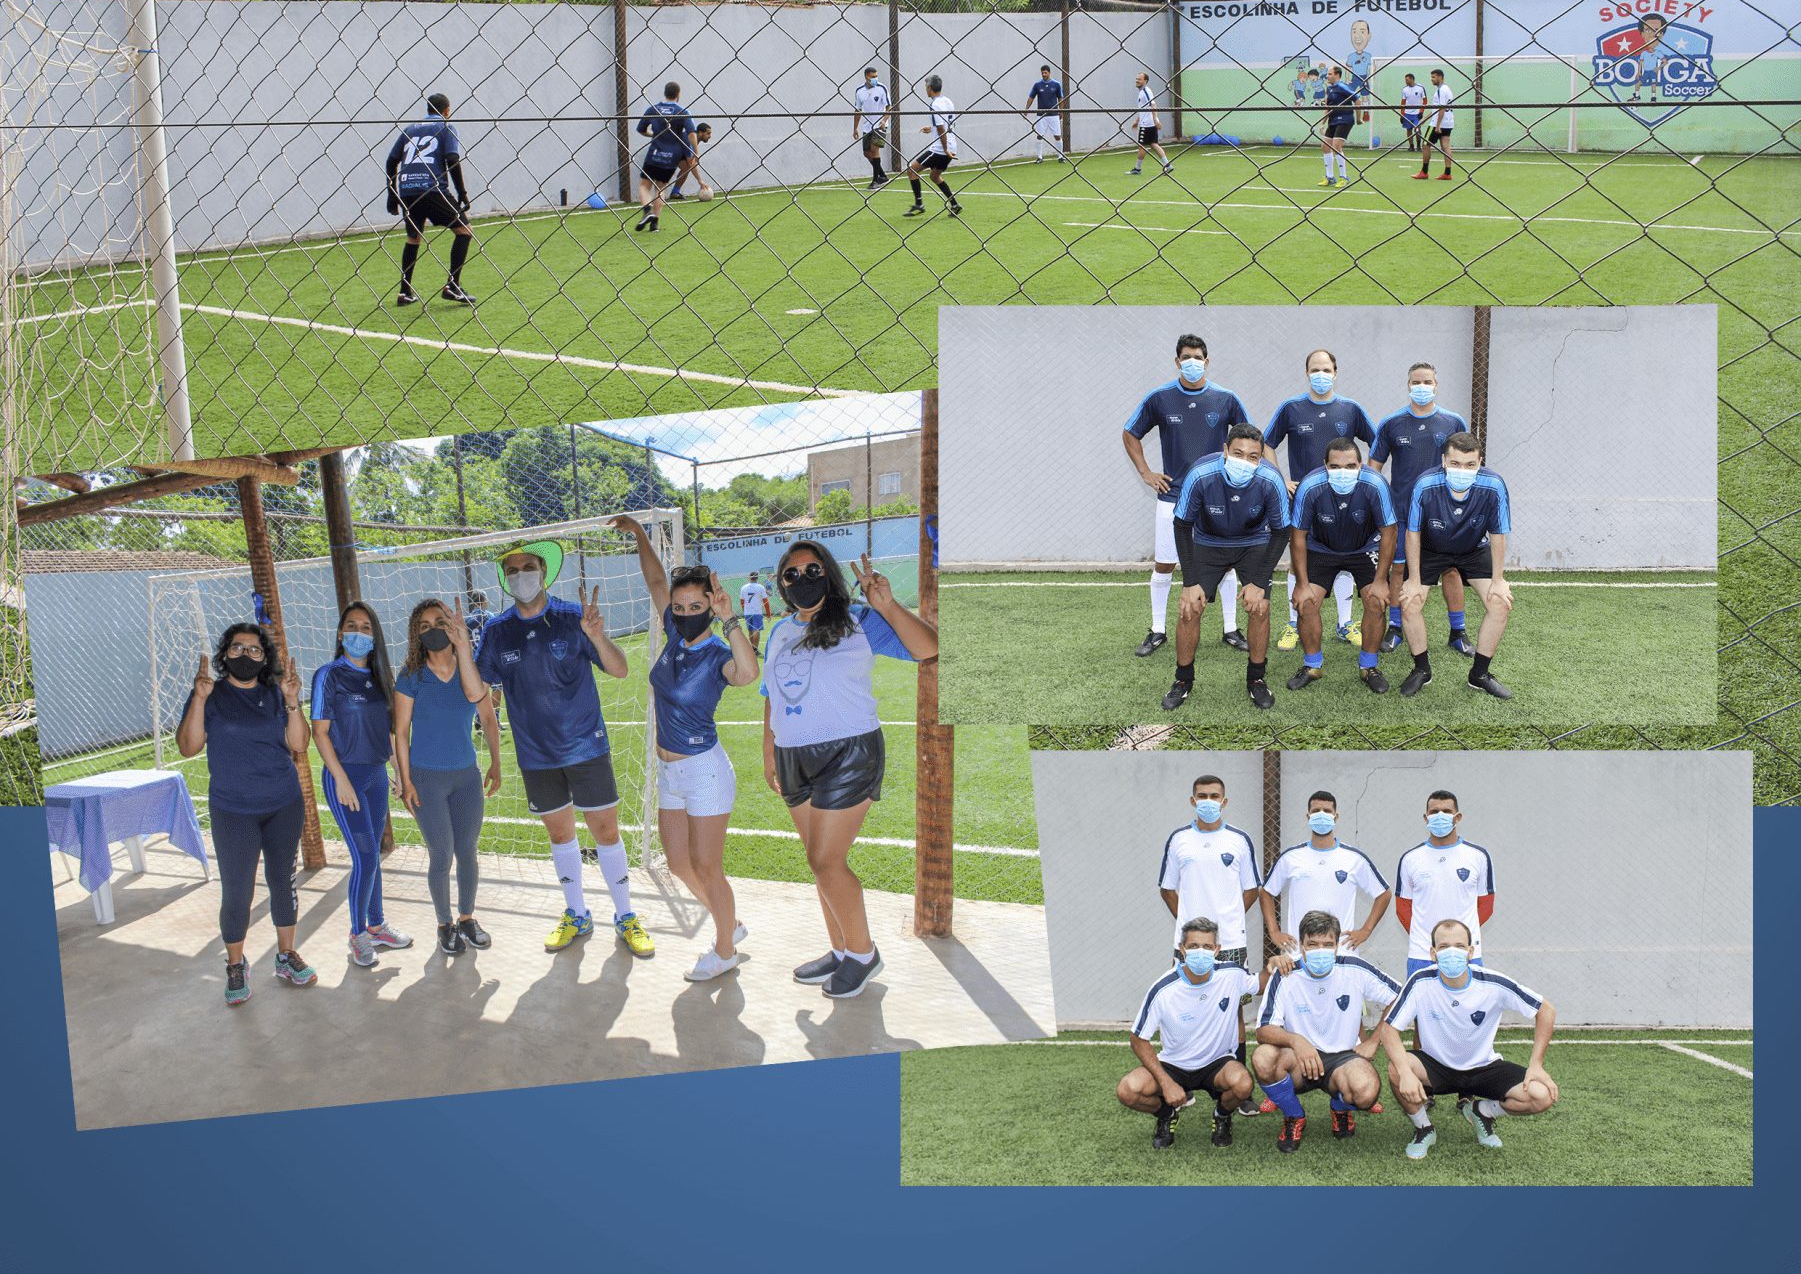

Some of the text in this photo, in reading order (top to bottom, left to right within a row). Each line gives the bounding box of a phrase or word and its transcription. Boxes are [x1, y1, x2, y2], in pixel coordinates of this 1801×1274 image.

[1189, 0, 1300, 20] ESCOLINHA
[1311, 0, 1338, 15] DE
[1664, 84, 1712, 97] Soccer
[403, 135, 438, 164] 12
[706, 537, 768, 553] ESCOLINHA
[798, 528, 853, 541] FUTEBOL
[747, 592, 755, 604] 7
